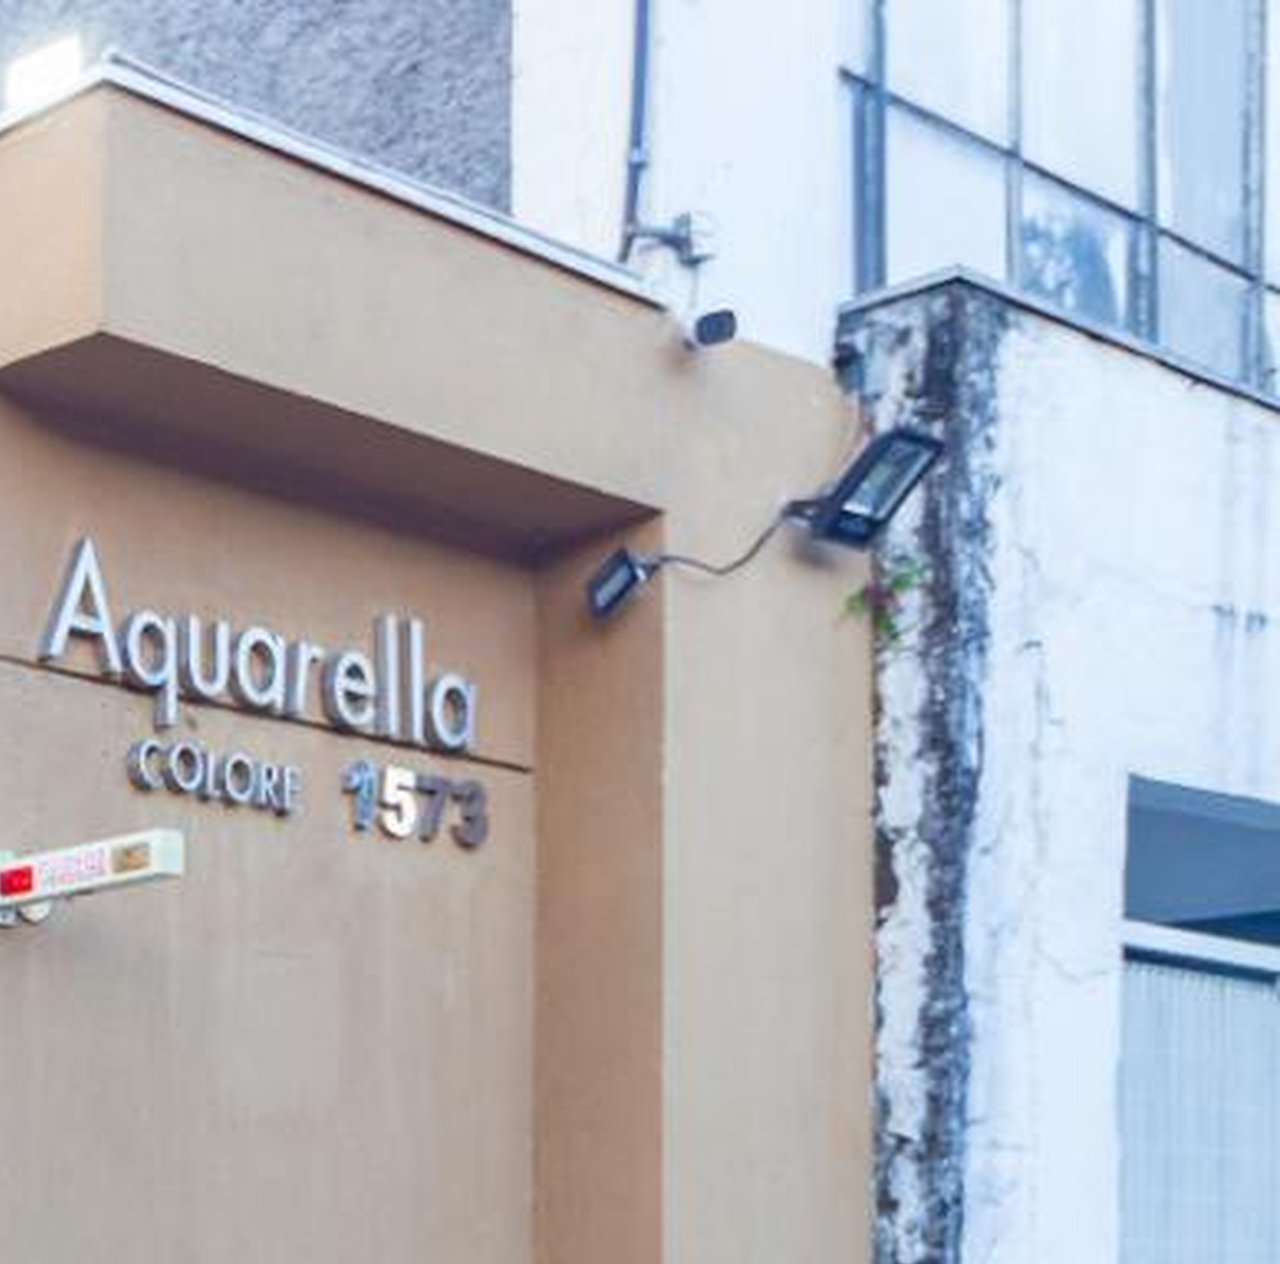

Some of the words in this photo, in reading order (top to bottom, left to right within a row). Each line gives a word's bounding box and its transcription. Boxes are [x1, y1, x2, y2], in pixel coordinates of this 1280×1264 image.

[42, 536, 476, 751] Aquarella
[128, 739, 301, 815] COLORE
[344, 760, 488, 848] 1573
